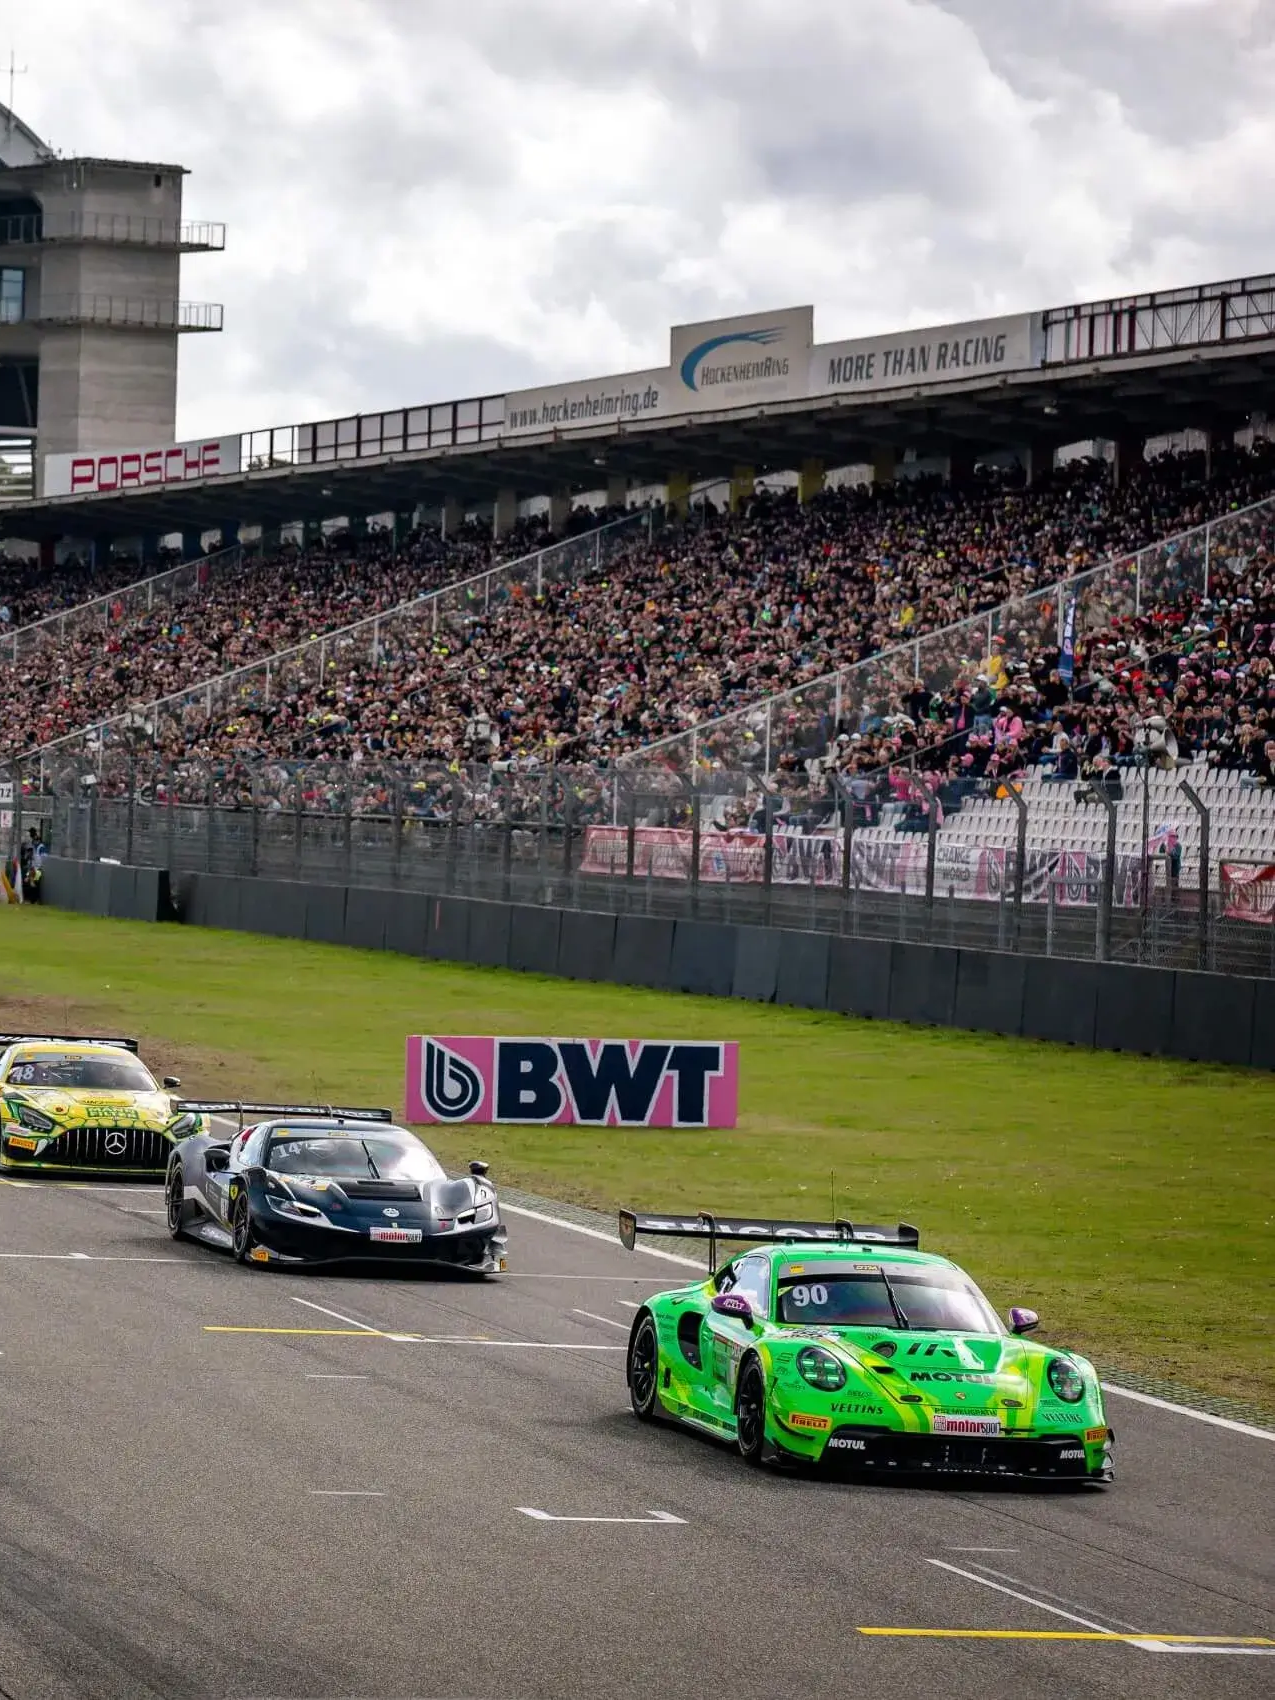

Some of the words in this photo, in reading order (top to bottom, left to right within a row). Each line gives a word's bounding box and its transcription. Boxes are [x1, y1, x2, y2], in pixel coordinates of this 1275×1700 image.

[828, 353, 875, 384] MORE
[882, 344, 931, 377] THAN
[936, 334, 1007, 370] RACING
[509, 386, 659, 430] www.hockenheimring.de
[70, 443, 221, 493] PORSCHE
[11, 1065, 36, 1080] 48
[492, 1039, 724, 1126] BWT
[277, 1141, 302, 1159] 14
[792, 1283, 829, 1308] 90
[830, 1402, 884, 1415] VELTINS
[791, 1414, 829, 1429] PIRELLI
[828, 1438, 866, 1450] MOTUL
[1060, 1449, 1085, 1460] MOTUL
